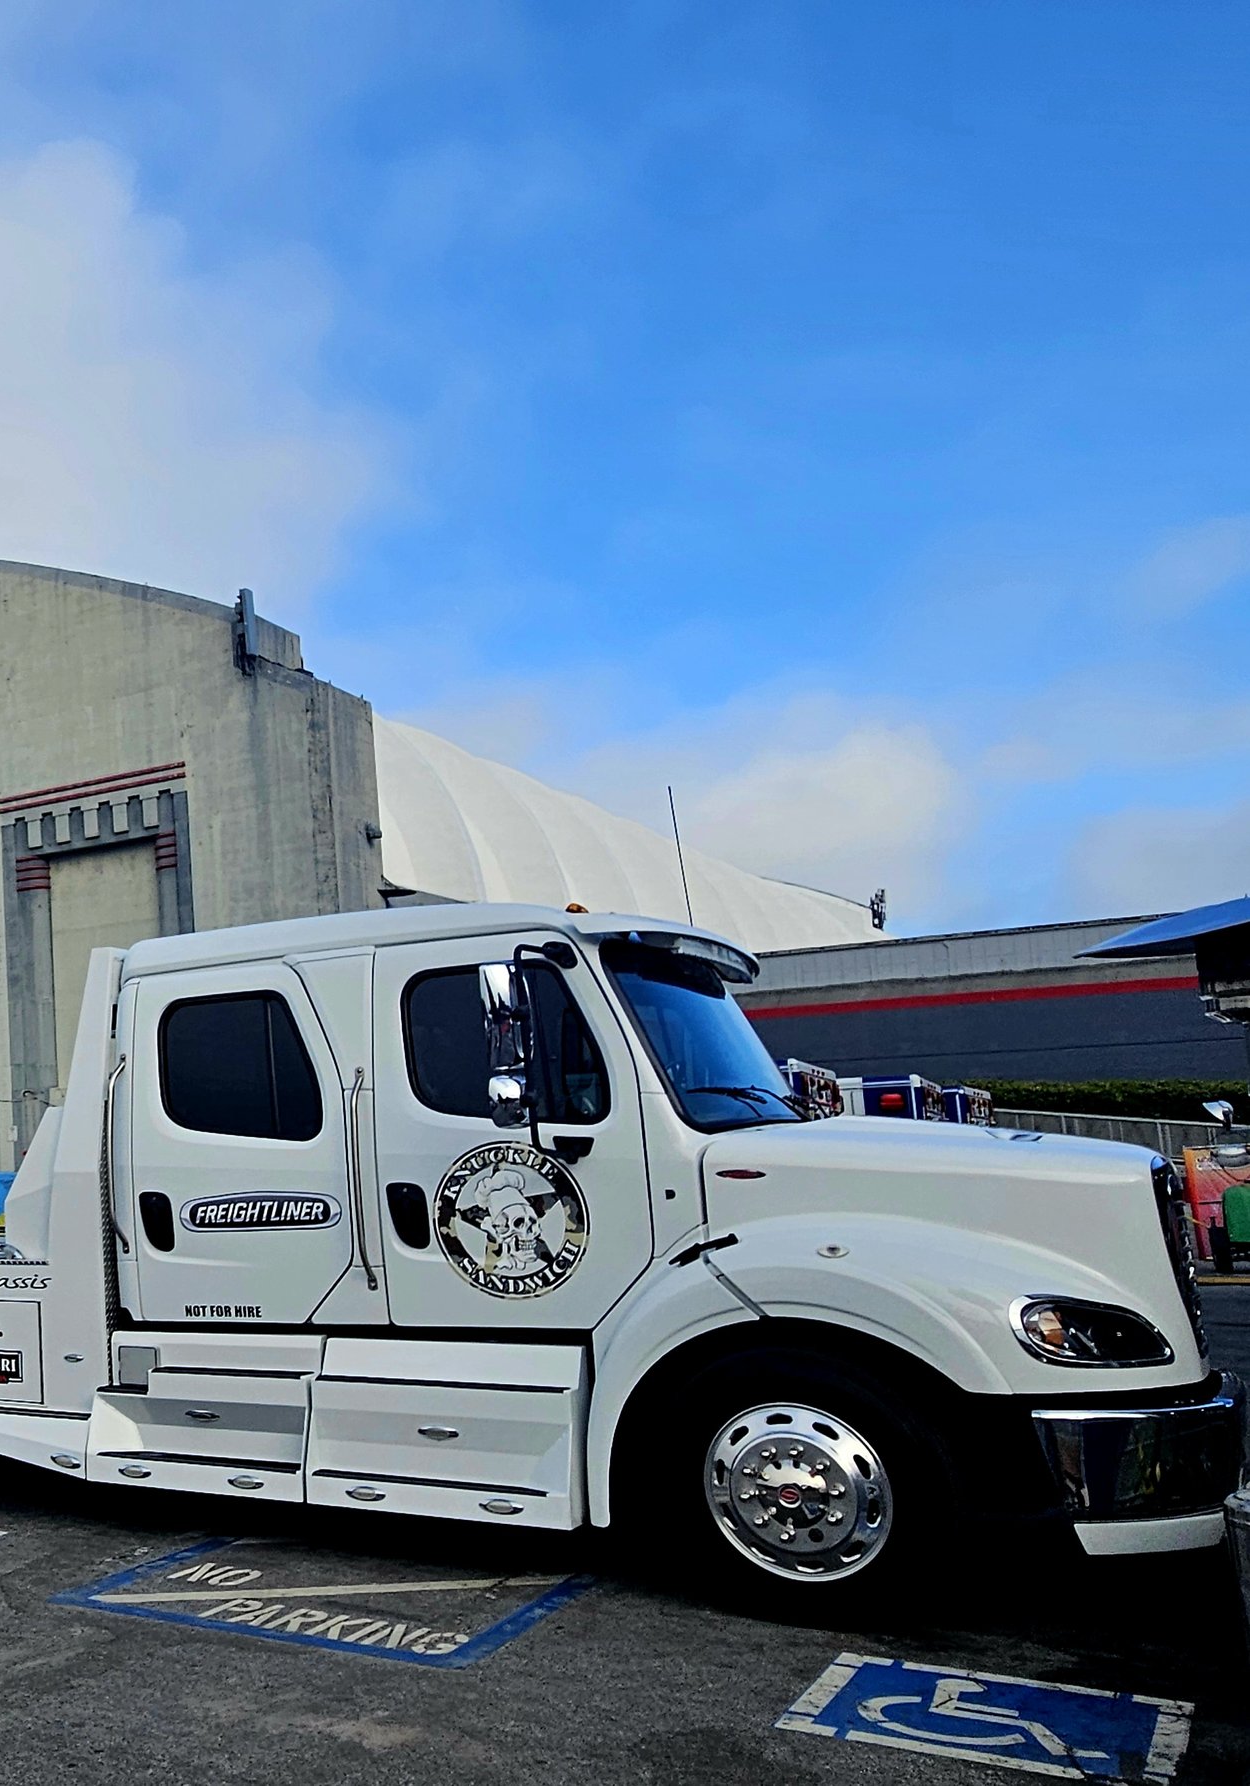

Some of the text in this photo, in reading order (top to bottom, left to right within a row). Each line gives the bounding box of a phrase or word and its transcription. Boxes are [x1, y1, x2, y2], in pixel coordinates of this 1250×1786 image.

[443, 1149, 558, 1200] KNUCKLE
[195, 1201, 324, 1224] FREIGHTLINER
[459, 1239, 581, 1293] SANDWICH
[185, 1305, 262, 1318] NOT FOR HIRE
[166, 1562, 263, 1586] NO
[198, 1598, 470, 1656] PARKING
